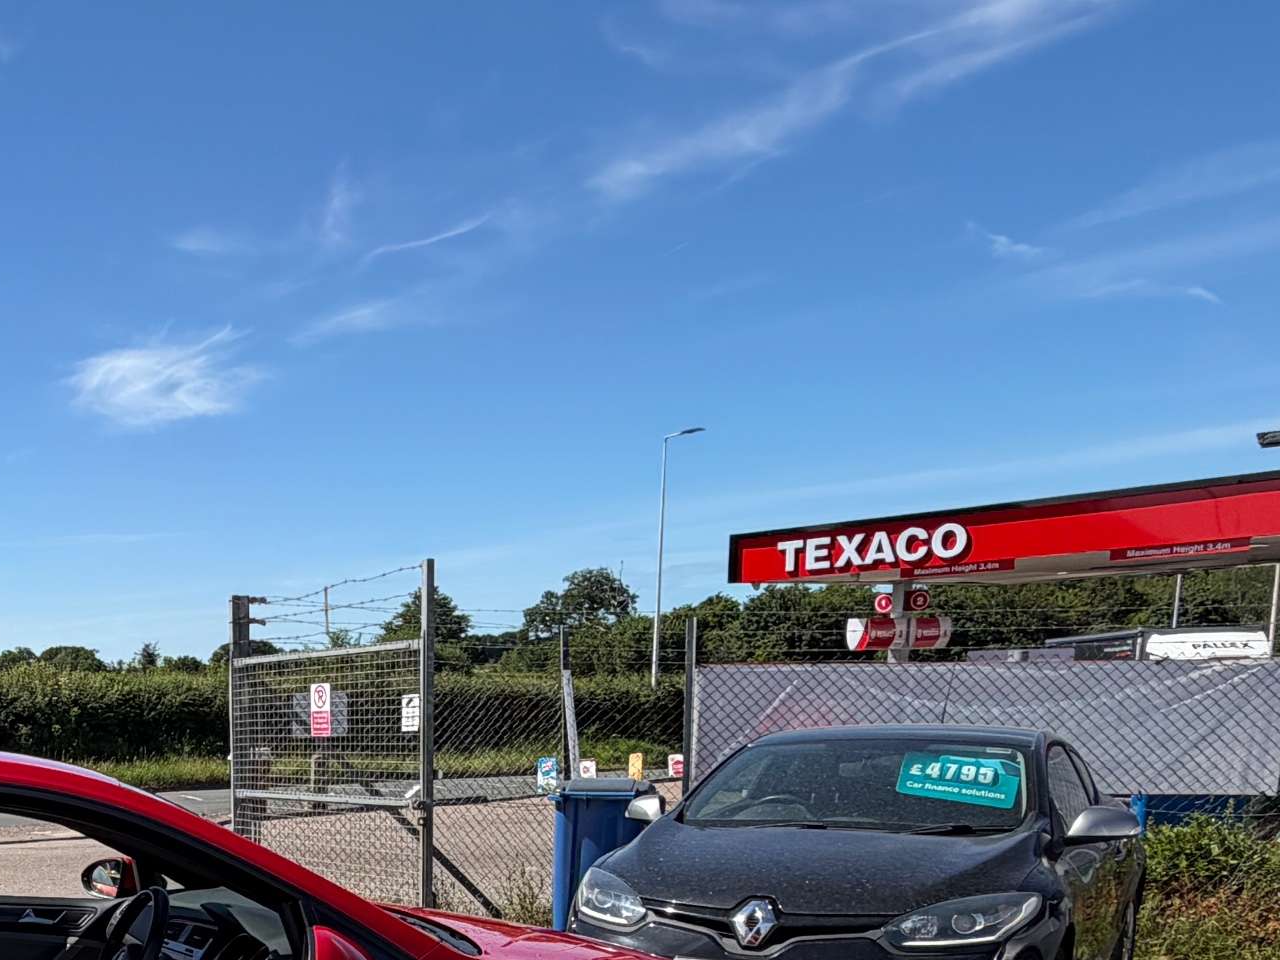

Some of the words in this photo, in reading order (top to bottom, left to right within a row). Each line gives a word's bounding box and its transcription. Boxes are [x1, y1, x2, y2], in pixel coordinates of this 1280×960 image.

[777, 523, 968, 572] TEXACO
[1173, 544, 1204, 555] Height
[951, 563, 977, 573] Height
[909, 762, 995, 784] £4795
[906, 781, 922, 789] Car
[924, 783, 960, 793] finance
[961, 788, 1005, 800] solutions
